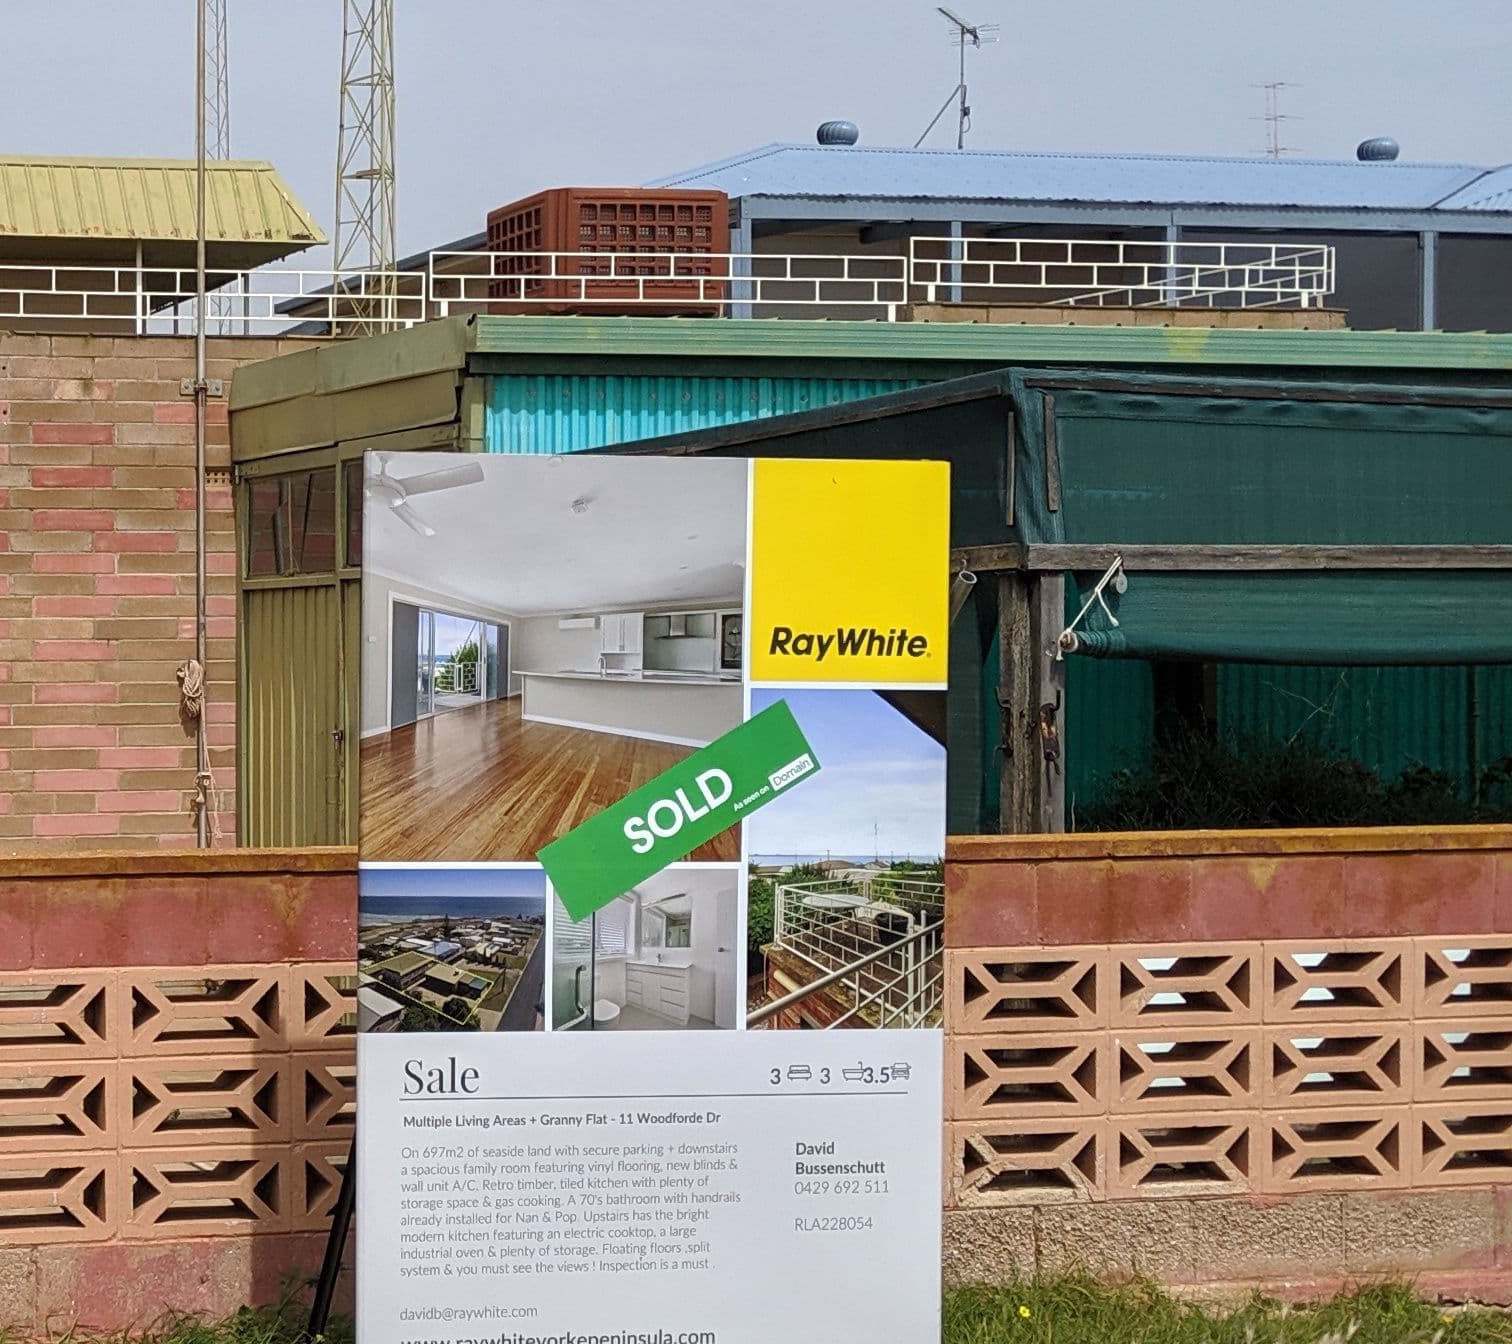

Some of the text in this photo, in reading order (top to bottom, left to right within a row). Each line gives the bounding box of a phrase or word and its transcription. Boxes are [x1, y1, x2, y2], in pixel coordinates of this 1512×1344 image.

[733, 759, 811, 812] As seen on Domain
[623, 768, 733, 854] SOLD
[404, 1057, 480, 1094] Sale
[770, 1067, 889, 1085] 3 3 3.5
[403, 1115, 452, 1129] Multiple
[456, 1114, 489, 1128] Living
[493, 1114, 526, 1126] Areas
[540, 1113, 582, 1127] Granny
[586, 1112, 608, 1125] Flat
[619, 1112, 633, 1124] 11
[637, 1111, 703, 1124] Woodforde
[706, 1111, 721, 1123] Dr
[401, 1146, 419, 1159] On
[423, 1146, 464, 1158] 697m2
[468, 1145, 479, 1157] of
[483, 1145, 524, 1157] seaside
[528, 1144, 551, 1156] land
[555, 1143, 579, 1156] with
[583, 1146, 619, 1155] secure
[623, 1142, 664, 1156] parking
[678, 1140, 738, 1153] downstairs
[796, 1142, 835, 1155] David
[401, 1167, 408, 1176] a
[411, 1163, 460, 1177] spacious
[464, 1162, 497, 1176] family
[501, 1165, 531, 1174] room
[535, 1160, 584, 1175] featuring
[588, 1160, 614, 1174] vinyl
[667, 1161, 690, 1170] new
[694, 1157, 726, 1170] blinds
[729, 1157, 738, 1169] &
[795, 1161, 885, 1175] Bussenschutt
[401, 1180, 424, 1192] wall
[427, 1179, 448, 1192] unit
[483, 1178, 513, 1191] Retro
[560, 1177, 584, 1189] tiled
[588, 1176, 628, 1189] kitchen
[631, 1175, 656, 1188] with
[659, 1175, 694, 1189] plenty
[697, 1174, 709, 1186] of
[794, 1180, 888, 1194] 0429 692 511
[401, 1197, 443, 1211] storage
[447, 1199, 479, 1210] space
[483, 1195, 492, 1208] &
[495, 1199, 514, 1209] gas
[567, 1194, 576, 1206] A
[580, 1193, 603, 1206] 70's
[606, 1192, 661, 1205] bathroom
[664, 1191, 688, 1204] with
[692, 1191, 741, 1203] handrails
[401, 1213, 441, 1228] already
[446, 1212, 492, 1225] installed
[496, 1212, 512, 1224] for
[516, 1211, 538, 1223] Nan
[542, 1211, 551, 1223] &
[583, 1209, 629, 1224] Upstairs
[633, 1209, 652, 1221] has
[655, 1208, 673, 1221] the
[677, 1208, 709, 1222] bright
[794, 1217, 873, 1231] RLA228054
[401, 1230, 444, 1242] modern
[448, 1229, 489, 1241] kitchen
[493, 1228, 544, 1242] featuring
[547, 1231, 560, 1239] an
[564, 1226, 604, 1239] electric
[660, 1228, 666, 1237] a
[670, 1224, 696, 1239] large
[401, 1247, 452, 1259] industrial
[456, 1249, 483, 1258] oven
[487, 1245, 497, 1258] &
[500, 1245, 535, 1259] plenty
[539, 1244, 550, 1257] of
[602, 1243, 646, 1257] Floating
[650, 1242, 681, 1254] floors
[400, 1263, 440, 1278] system
[444, 1263, 453, 1275] &
[456, 1266, 478, 1276] you
[481, 1262, 510, 1274] must
[513, 1265, 532, 1274] see
[535, 1261, 554, 1273] the
[557, 1260, 588, 1273] views
[600, 1259, 656, 1274] Inspection
[660, 1258, 668, 1271] is
[672, 1262, 678, 1270] a
[681, 1258, 709, 1270] must
[400, 1305, 538, 1321] davidb@raywhite.com
